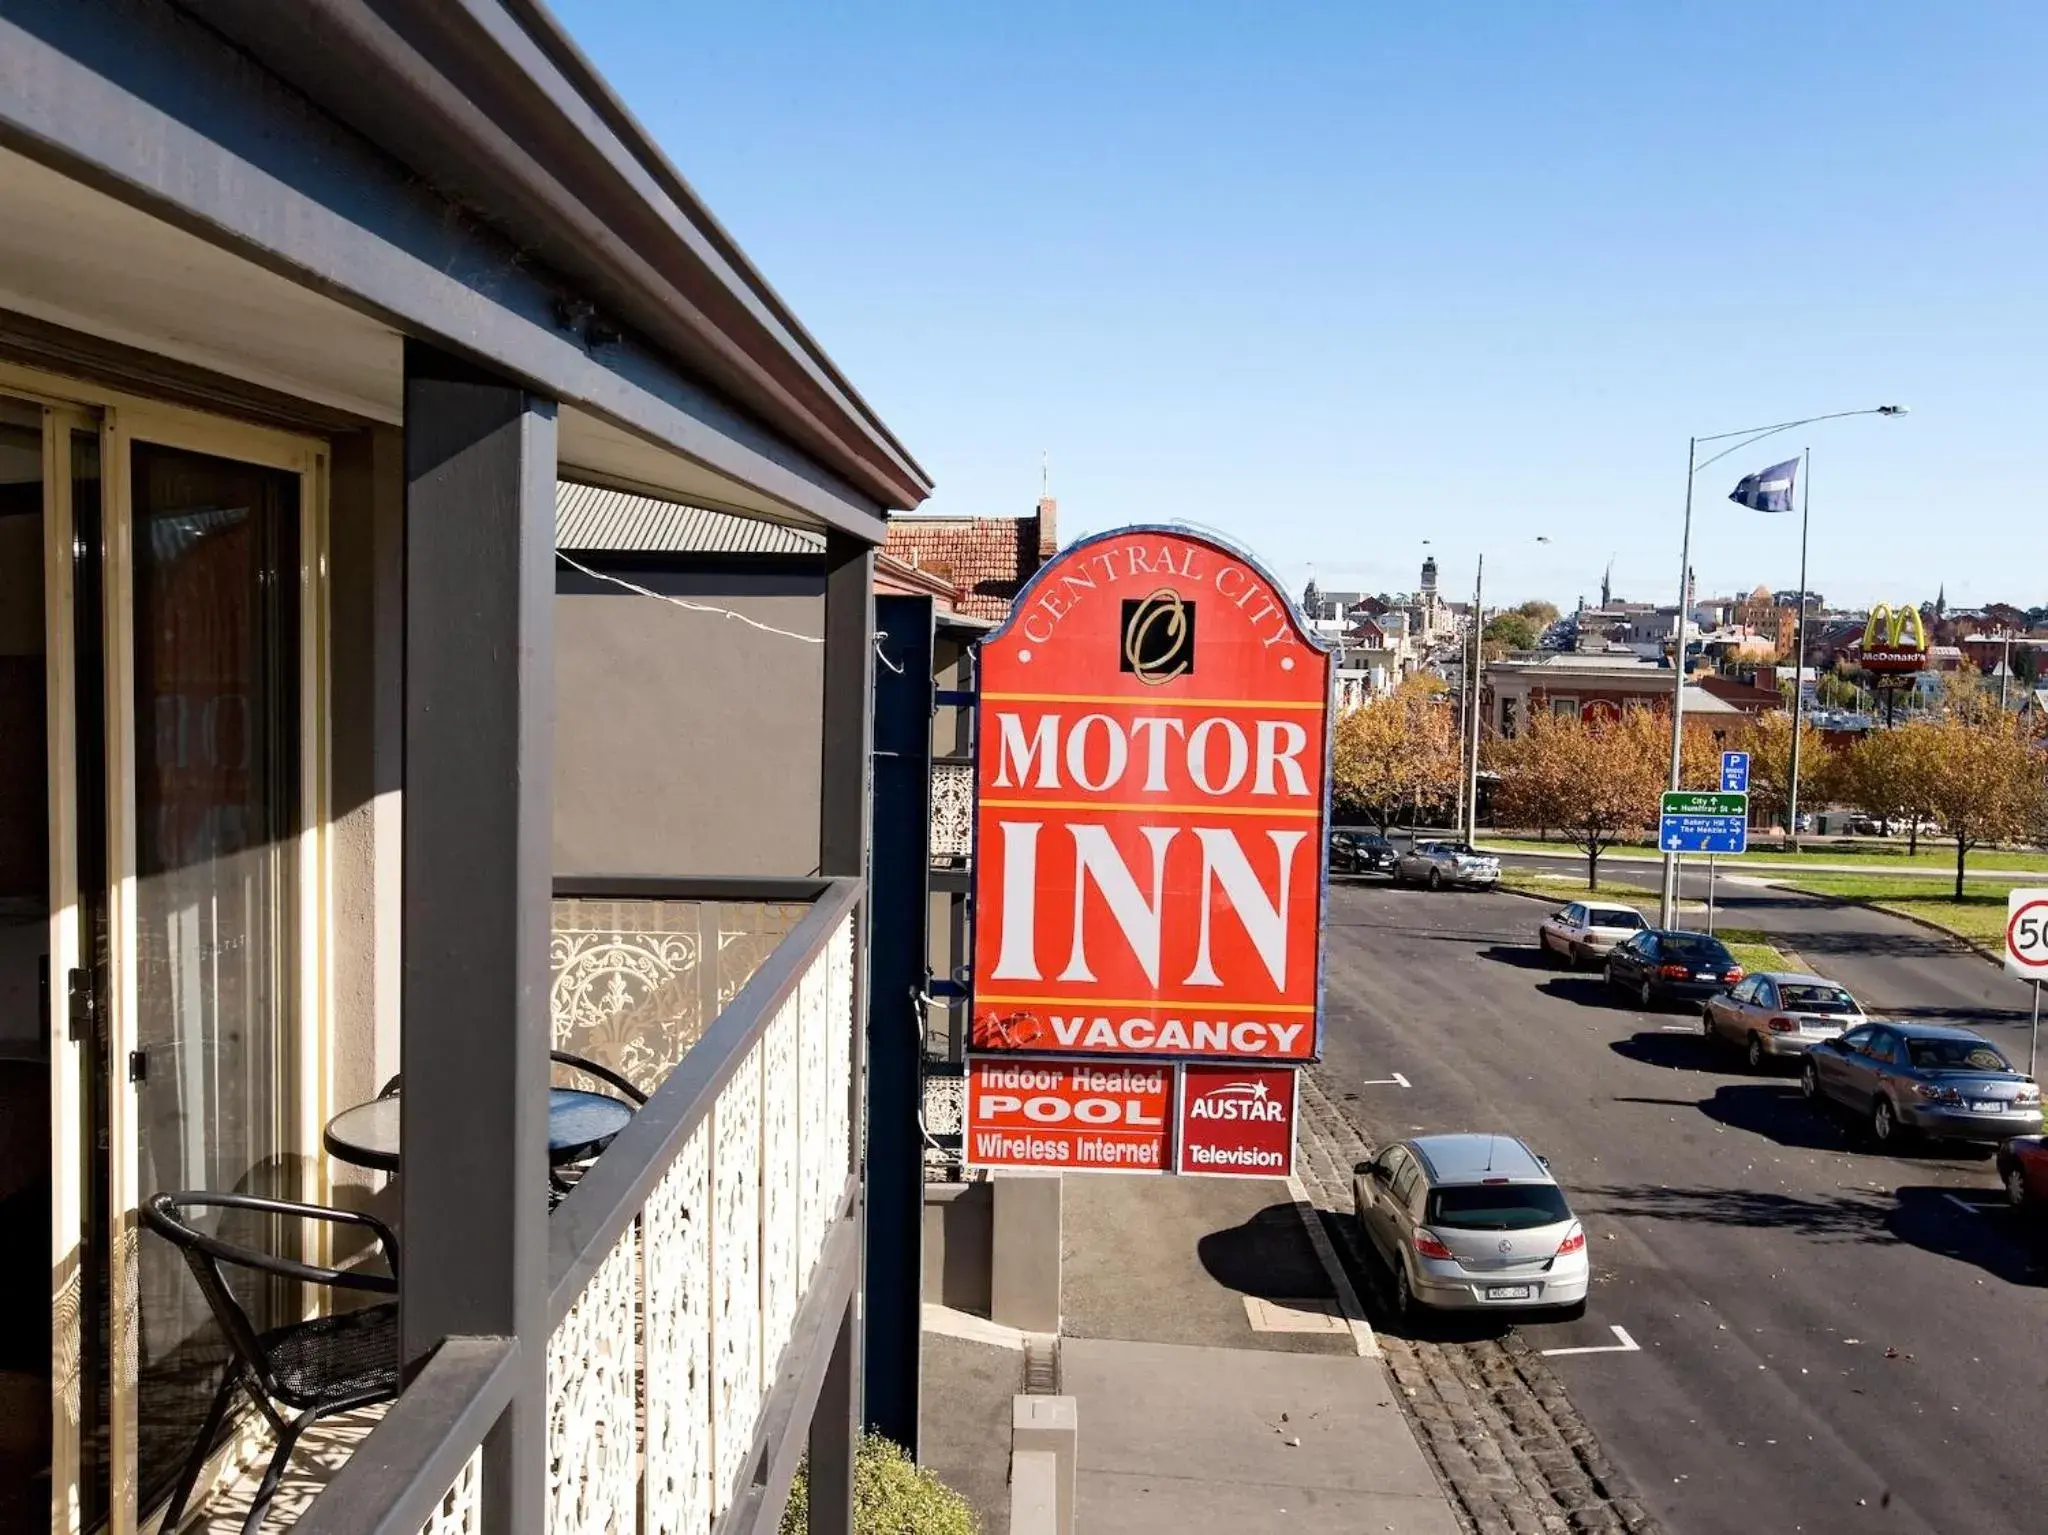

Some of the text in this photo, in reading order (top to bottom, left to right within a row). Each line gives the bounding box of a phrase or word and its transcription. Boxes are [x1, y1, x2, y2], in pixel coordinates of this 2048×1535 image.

[1024, 545, 1300, 649] CENTRAL CITY
[1862, 652, 1926, 662] McDonald's
[992, 712, 1311, 797] MOTOR
[1730, 755, 1740, 767] P
[1691, 797, 1708, 807] City
[1720, 805, 1728, 813] St
[991, 819, 1308, 995] INN
[1049, 1015, 1305, 1053] VACANCY
[981, 1064, 1162, 1094] Indoor Heated
[978, 1095, 1162, 1125] POOL
[976, 1132, 1160, 1165] Wireless Internet
[1189, 1144, 1283, 1168] Television
